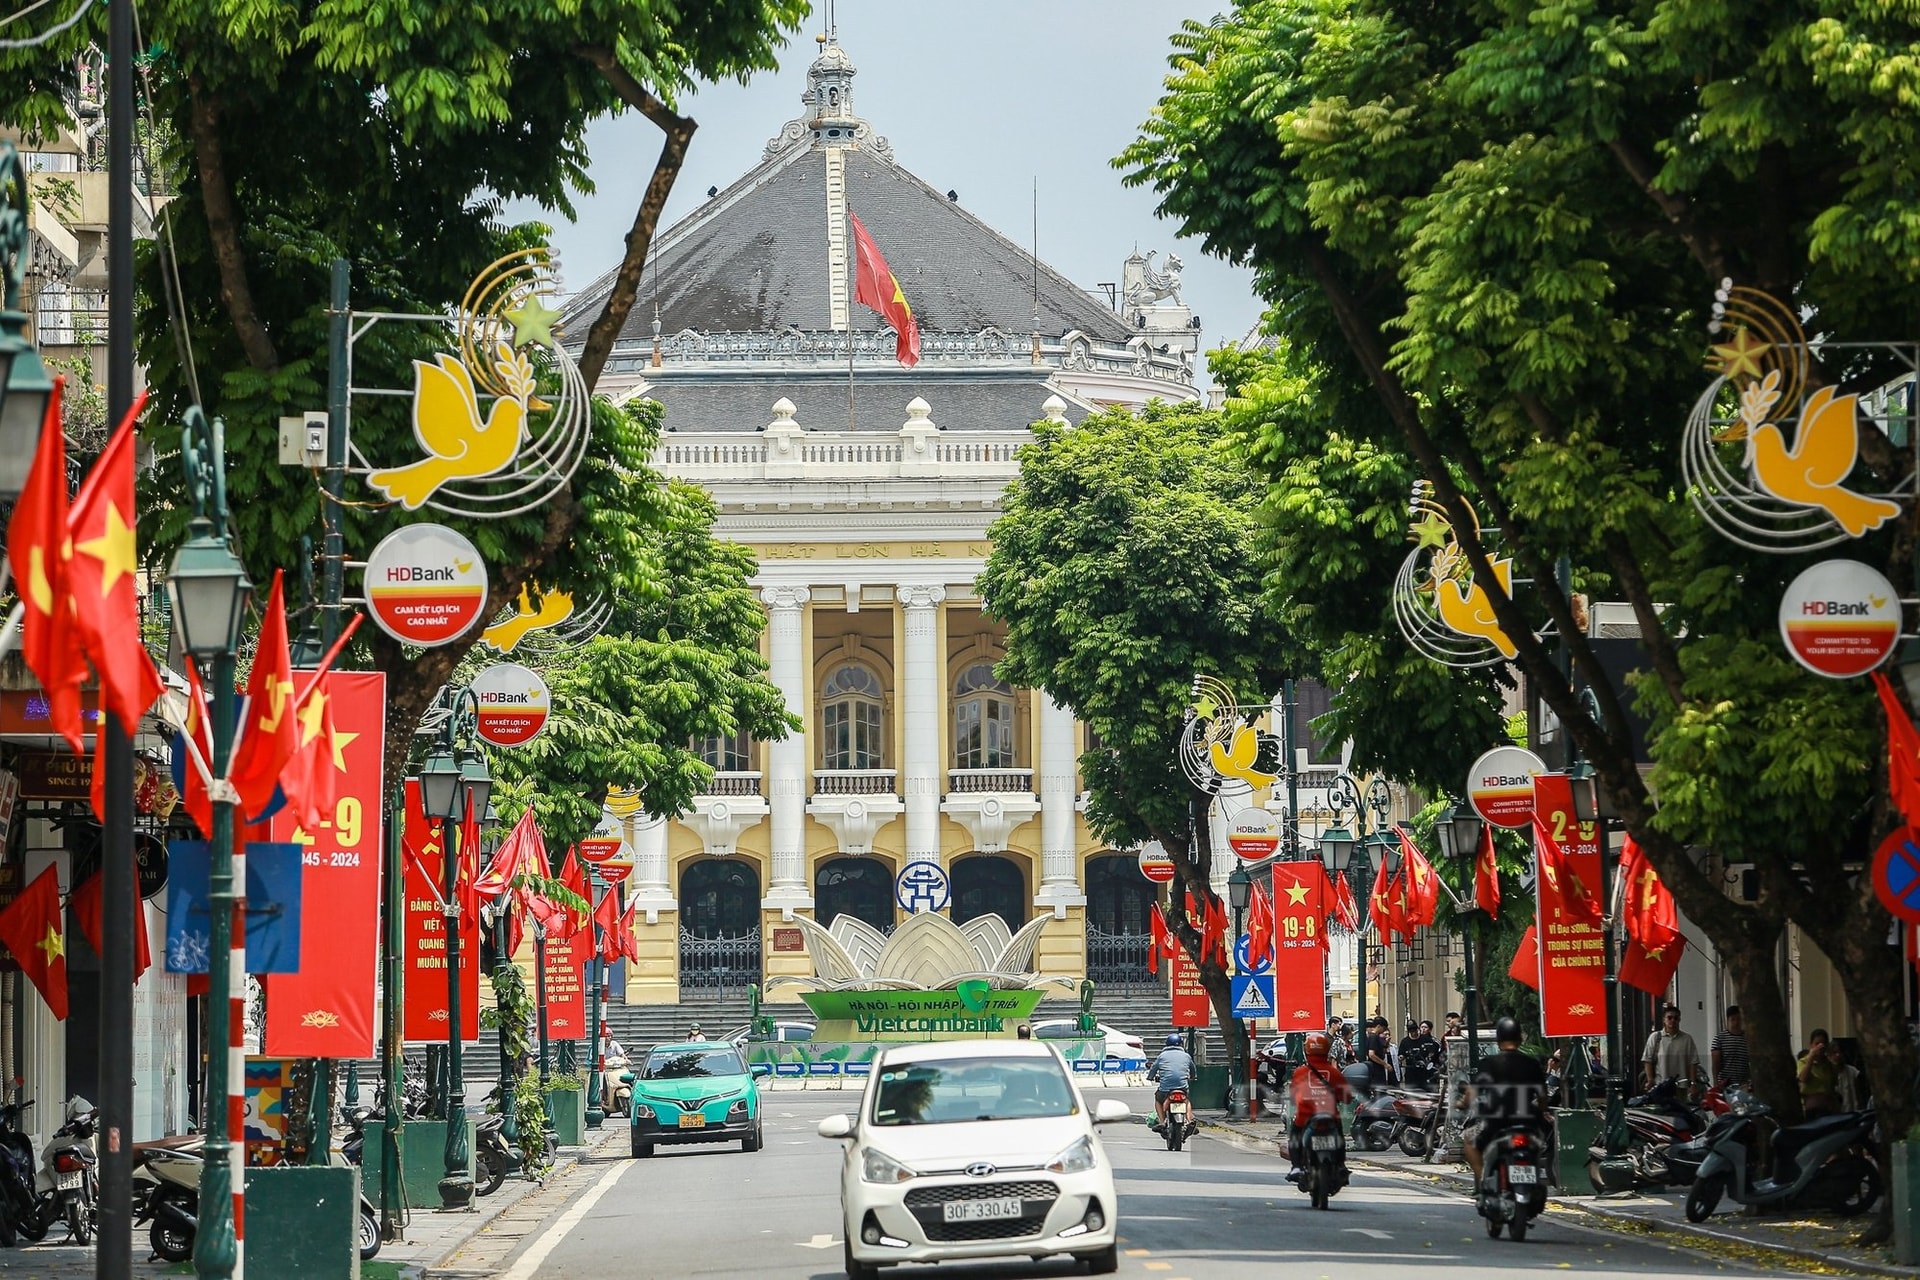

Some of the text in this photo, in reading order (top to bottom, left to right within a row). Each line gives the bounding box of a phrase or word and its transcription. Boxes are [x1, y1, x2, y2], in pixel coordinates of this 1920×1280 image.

[765, 543, 816, 559] HÁT
[836, 541, 890, 558] LỚN
[911, 541, 946, 557] HÀ
[387, 566, 455, 582] HDBank
[394, 603, 460, 617] CAM KẾT LỢI ÍCH
[1802, 601, 1870, 616] HDBank
[407, 615, 448, 626] CAO NHẤT
[1814, 637, 1872, 645] COMMITTED TO
[1807, 647, 1880, 655] YOUR BEST RETURNS
[480, 692, 528, 704] HDBank
[499, 718, 509, 726] KẾT
[48, 777, 77, 786] SINCE
[1482, 775, 1530, 787] HDBank
[1236, 825, 1267, 834] HDBank
[1577, 845, 1598, 855] 2024
[302, 853, 321, 866] 45
[331, 853, 360, 867] 2024
[410, 898, 432, 912] ĐẢNG
[423, 919, 440, 933] VIỆT
[1282, 916, 1315, 938] 19-8
[418, 938, 445, 951] QUANG
[1283, 940, 1297, 948] 1945
[1301, 939, 1316, 947] 2024
[1547, 937, 1604, 952] TRONG SỰ NGHIỆ
[417, 957, 440, 968] MUÔN
[1552, 954, 1566, 967] CỦA
[1567, 954, 1592, 967] CHÚNG
[1593, 955, 1601, 965] TA
[849, 1000, 865, 1011] HÀ
[866, 999, 889, 1012] NỘI
[900, 999, 920, 1012] HỘI
[925, 1000, 959, 1012] NHẬP
[992, 997, 1020, 1010] TRIỂN
[855, 1012, 1005, 1033] Vietcombank
[947, 1201, 1019, 1220] 30F-330.45
